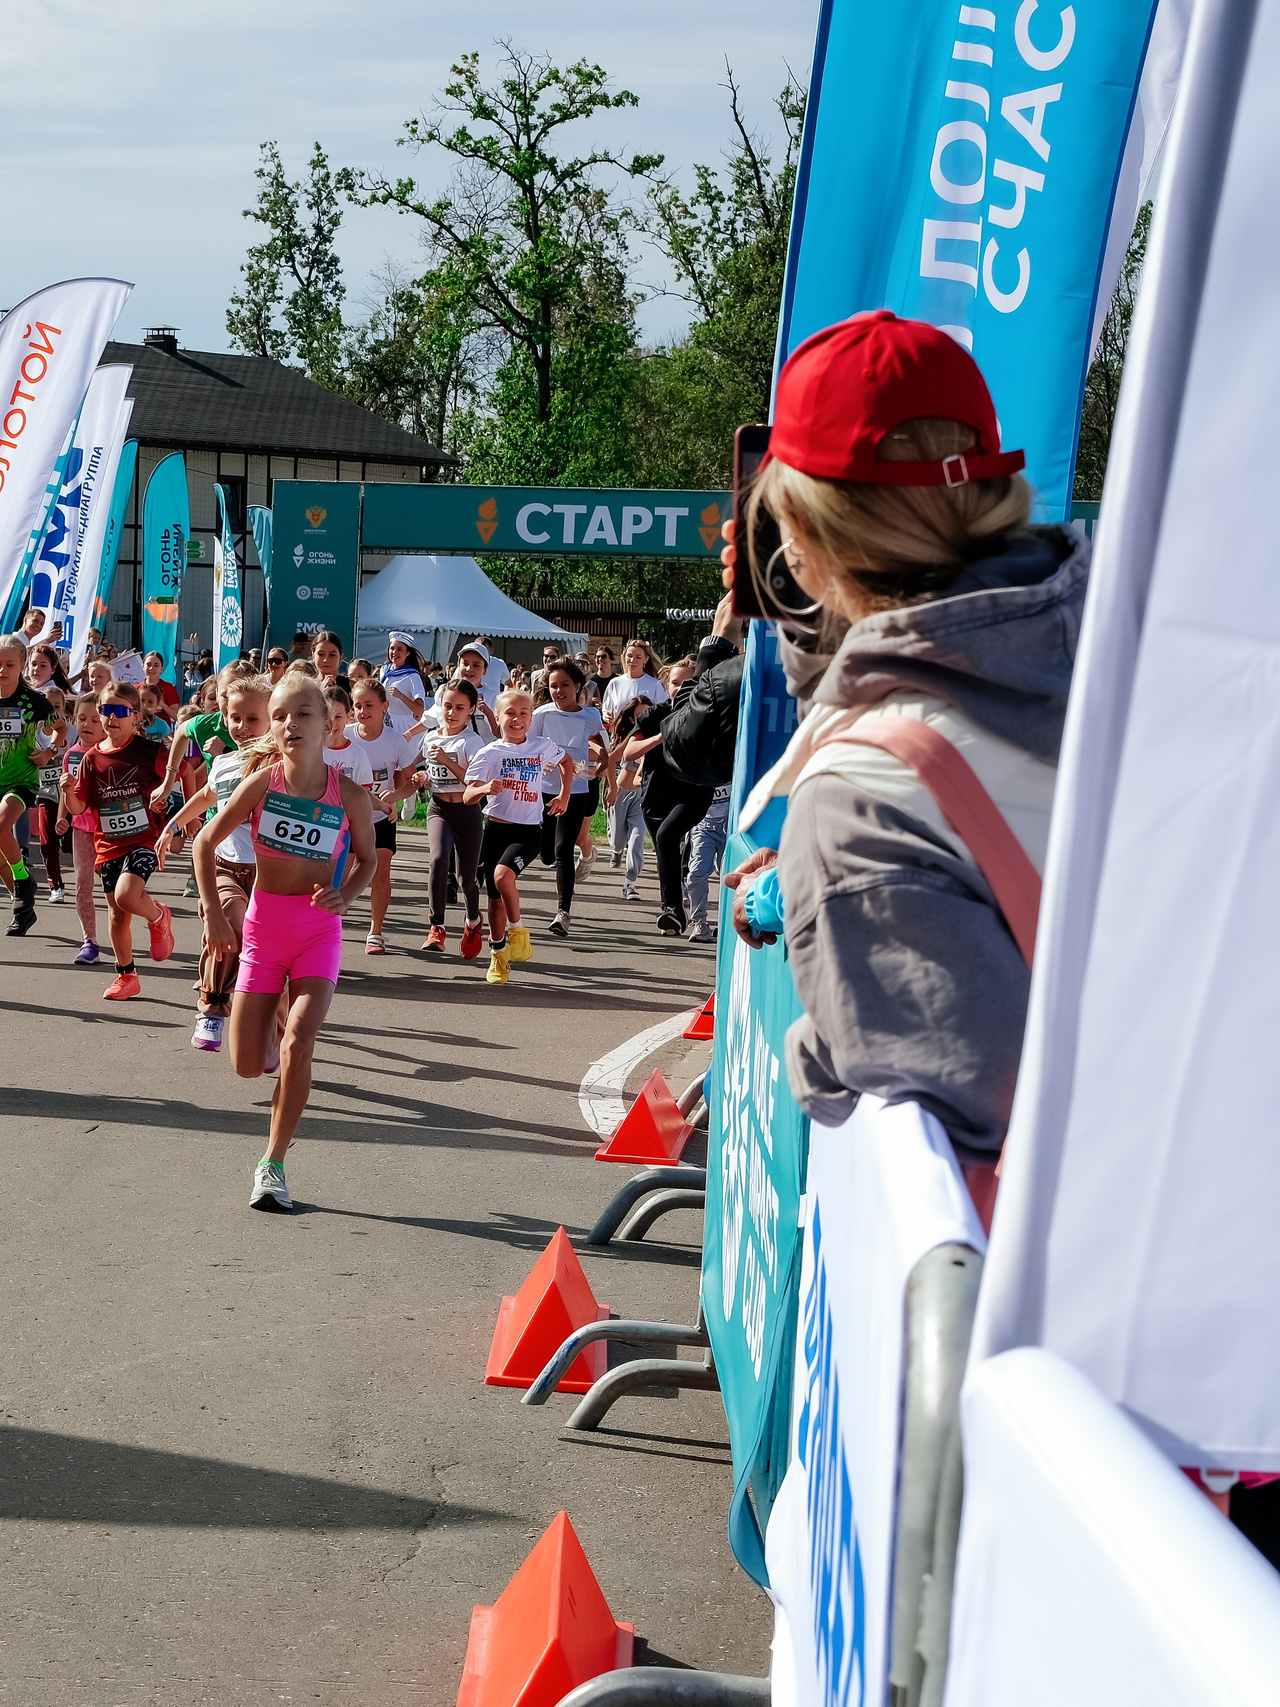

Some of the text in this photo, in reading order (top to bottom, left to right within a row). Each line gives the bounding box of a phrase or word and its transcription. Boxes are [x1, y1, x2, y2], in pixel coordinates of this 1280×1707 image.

[515, 502, 689, 547] СТАРТ
[160, 528, 172, 586] ОГОНЬ
[431, 766, 448, 778] 613
[502, 779, 529, 791] ВМЕСТЕ
[109, 814, 137, 830] 659
[274, 820, 321, 846] 620
[742, 1234, 766, 1382] CLUB
